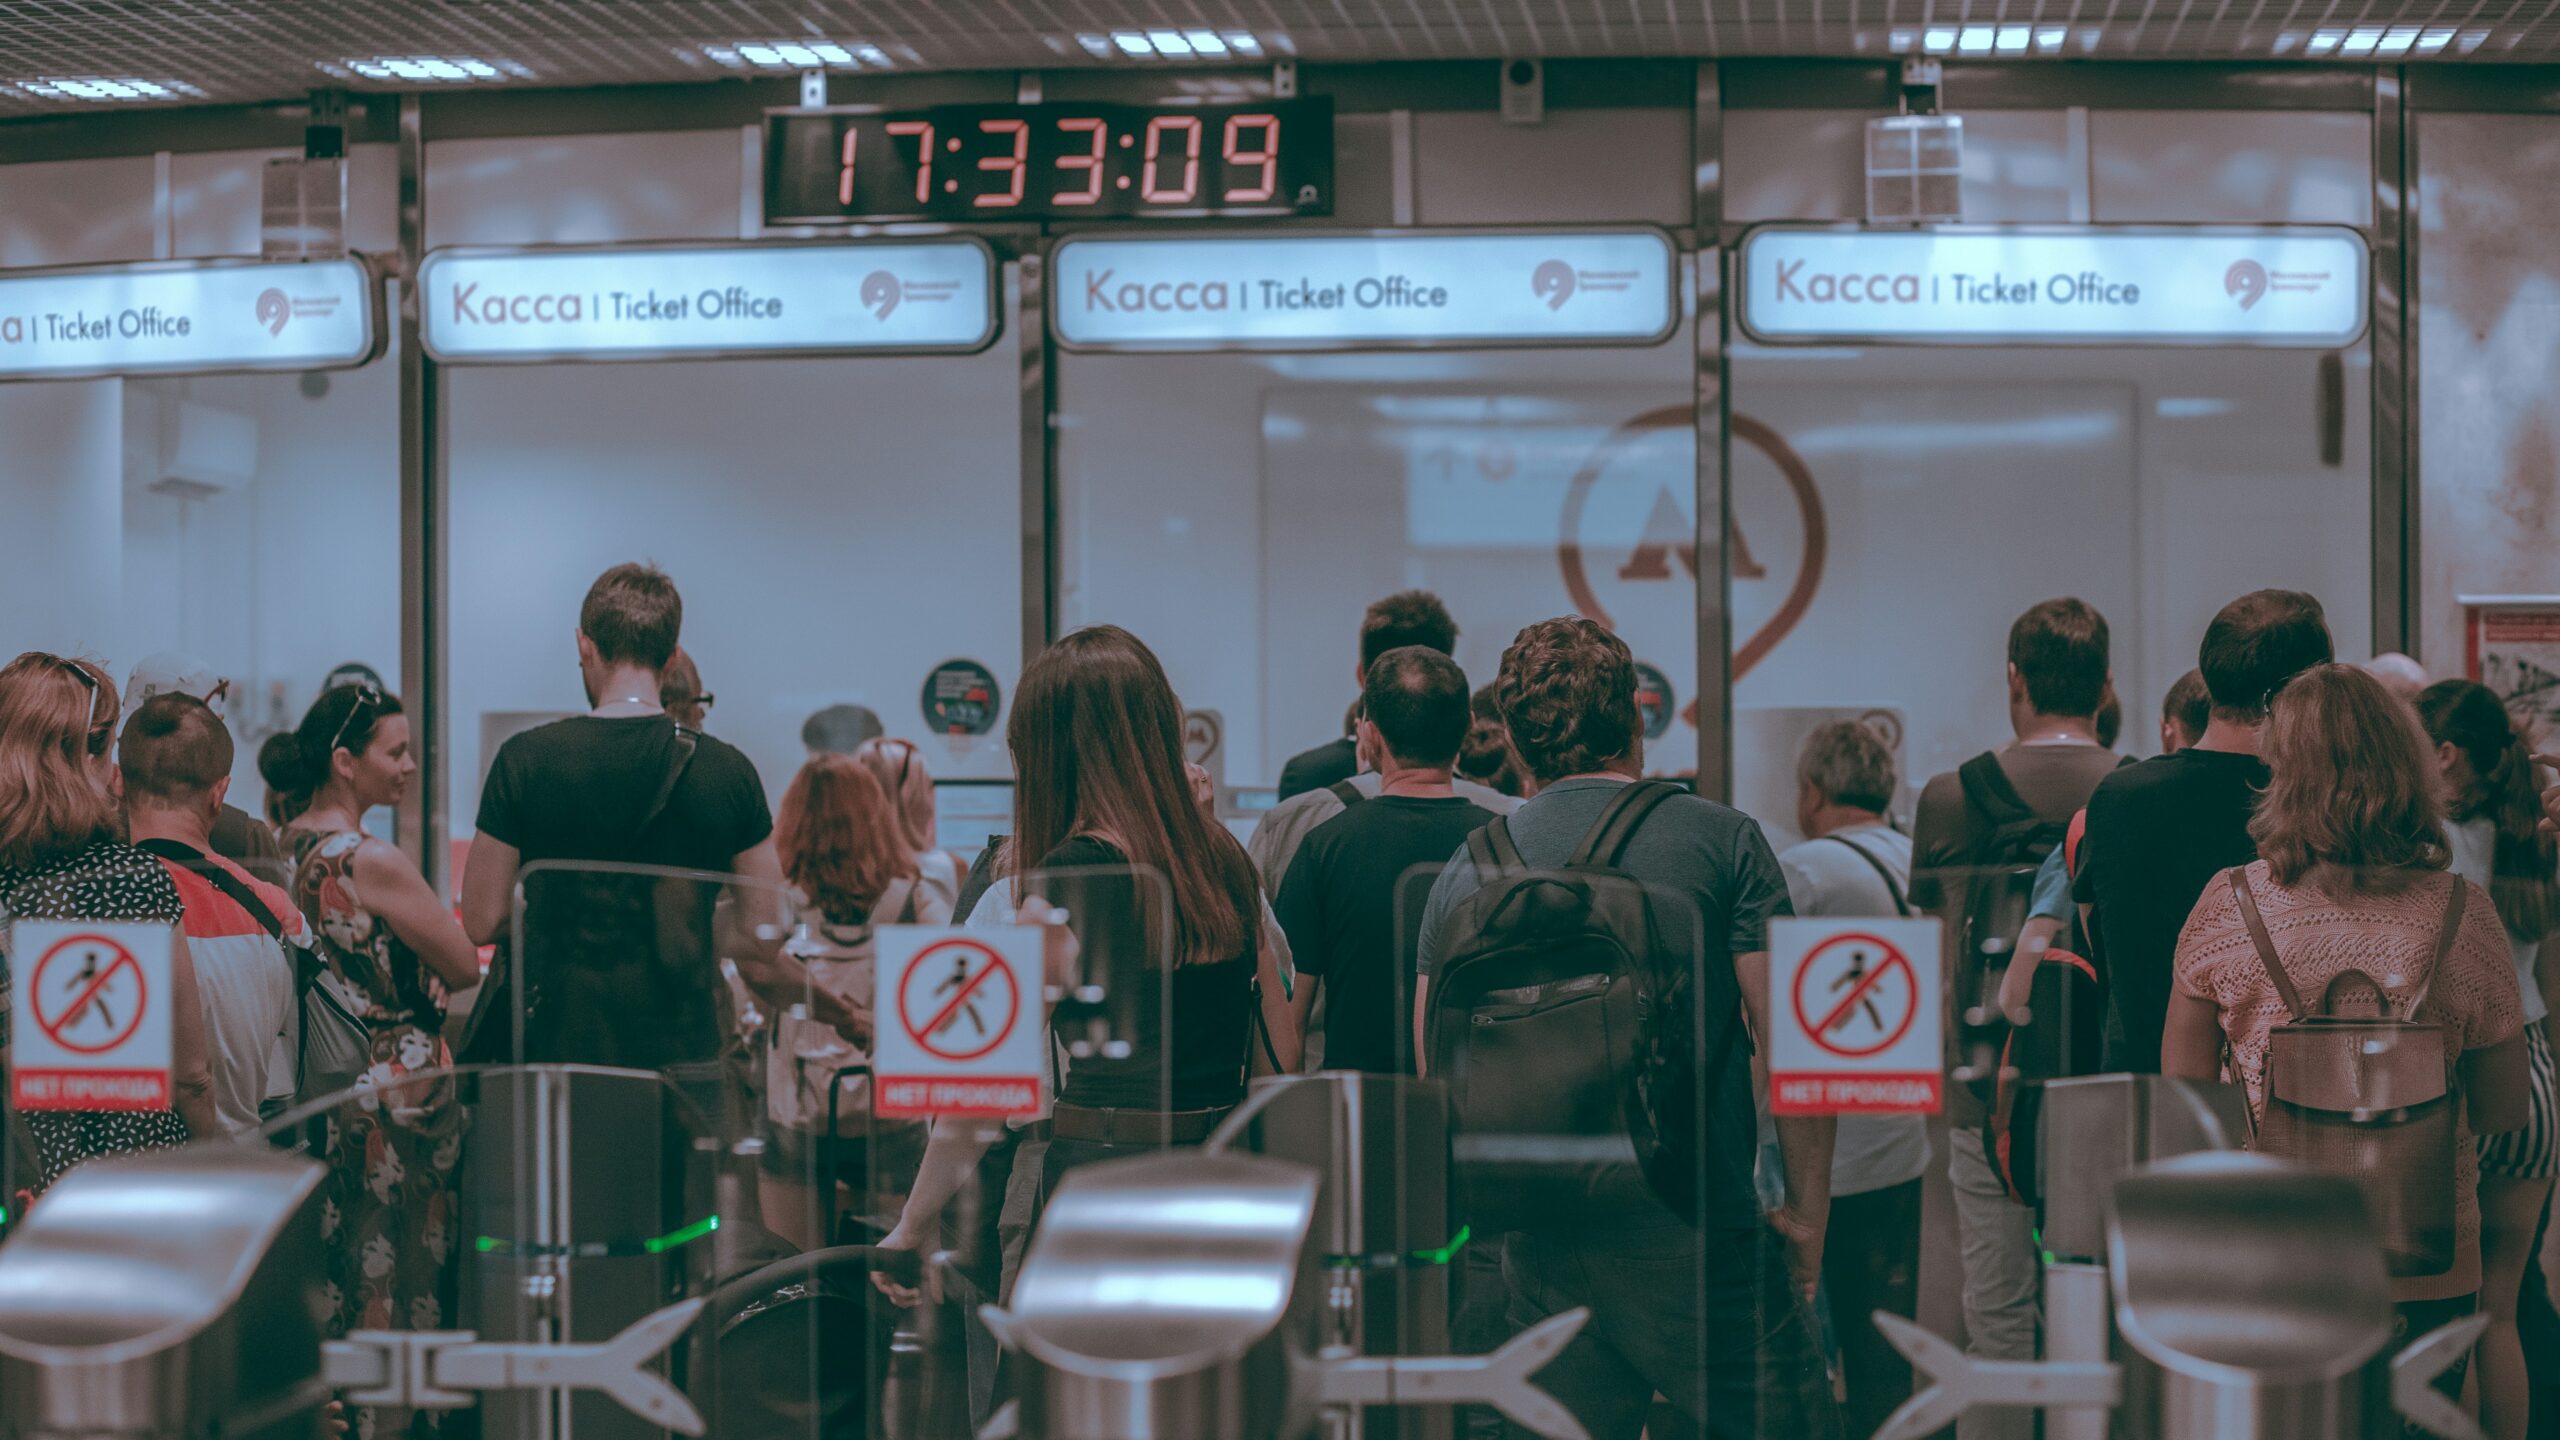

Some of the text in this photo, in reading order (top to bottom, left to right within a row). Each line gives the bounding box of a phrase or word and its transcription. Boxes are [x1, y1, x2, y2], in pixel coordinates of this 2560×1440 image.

[839, 113, 1281, 206] 17:33:09
[452, 281, 783, 325] Касса Ticket Office
[1085, 269, 1448, 312] Касса Ticket Office
[1775, 258, 2140, 305] Касса Ticket Office
[45, 309, 111, 342] Ticket
[118, 305, 191, 339] Office
